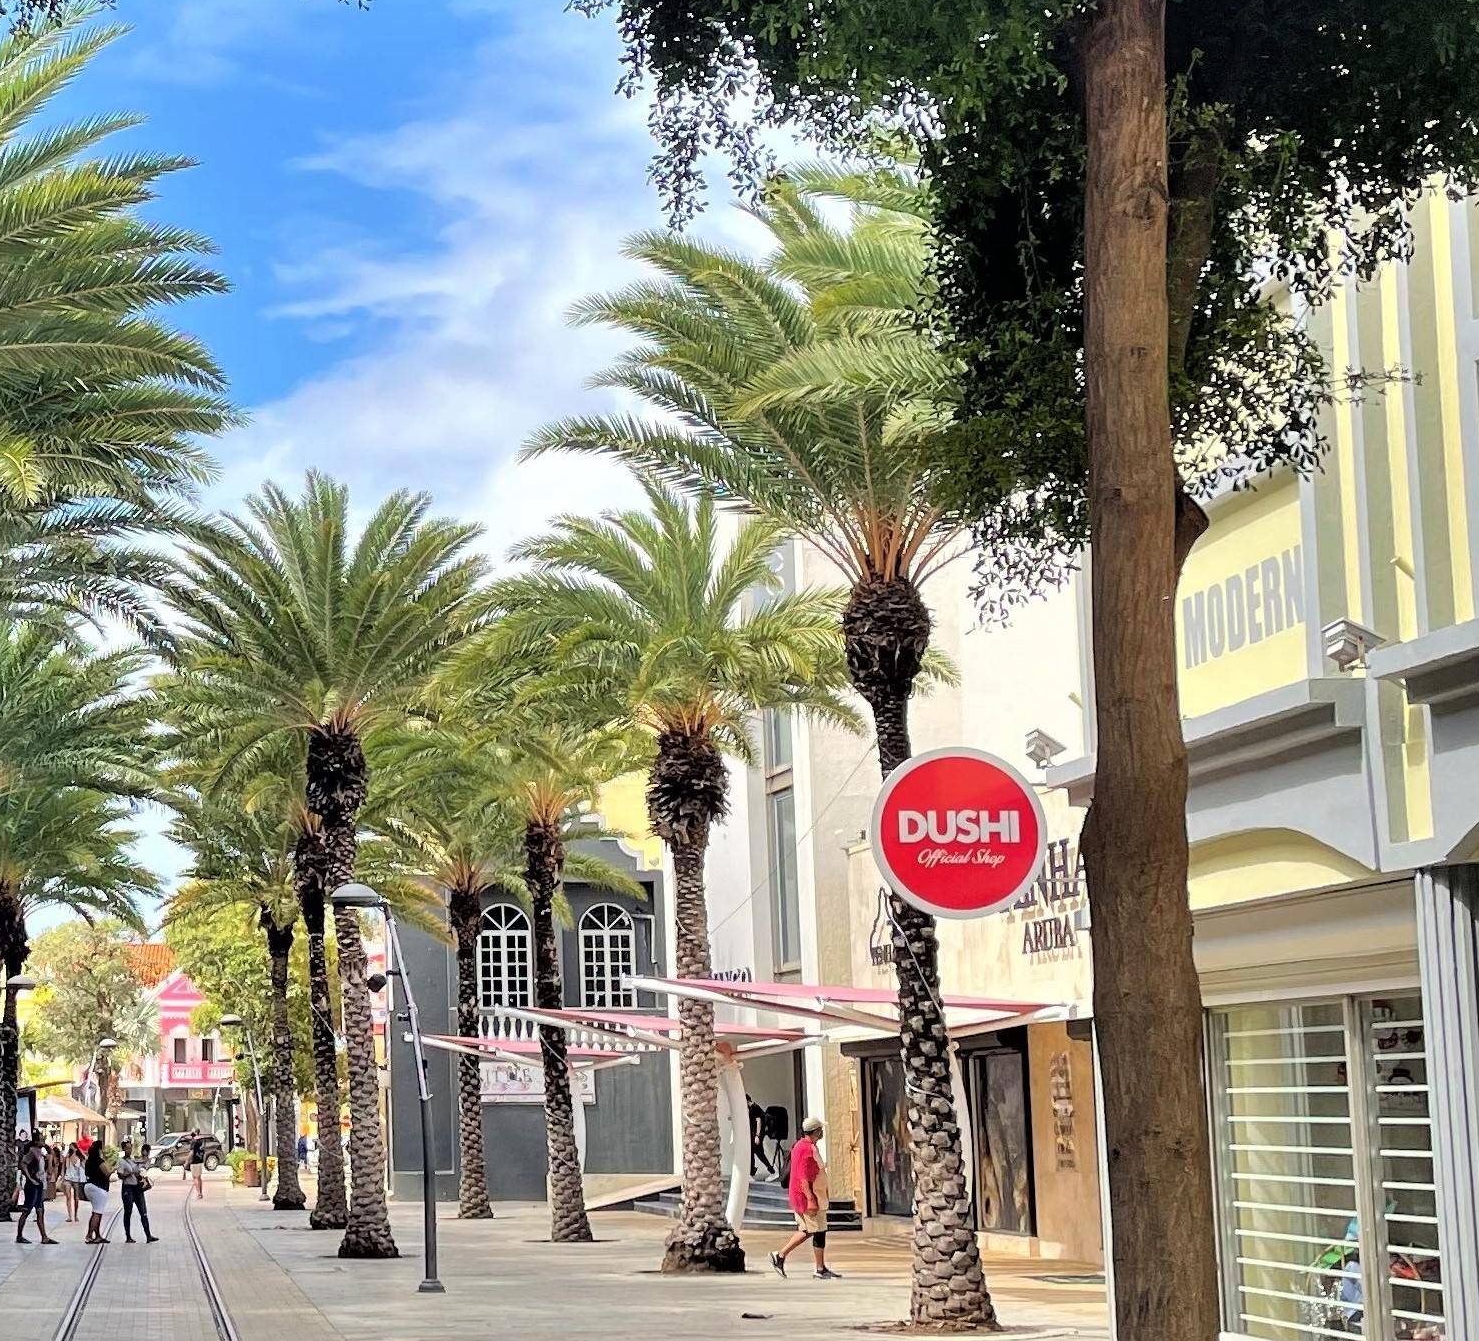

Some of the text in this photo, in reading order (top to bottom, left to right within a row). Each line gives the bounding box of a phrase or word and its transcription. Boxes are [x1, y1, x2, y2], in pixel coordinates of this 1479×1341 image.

[1182, 544, 1305, 669] MODERN
[898, 810, 1021, 844] DUSHI
[917, 849, 1006, 868] Official Shop
[1022, 914, 1078, 954] ARUBA
